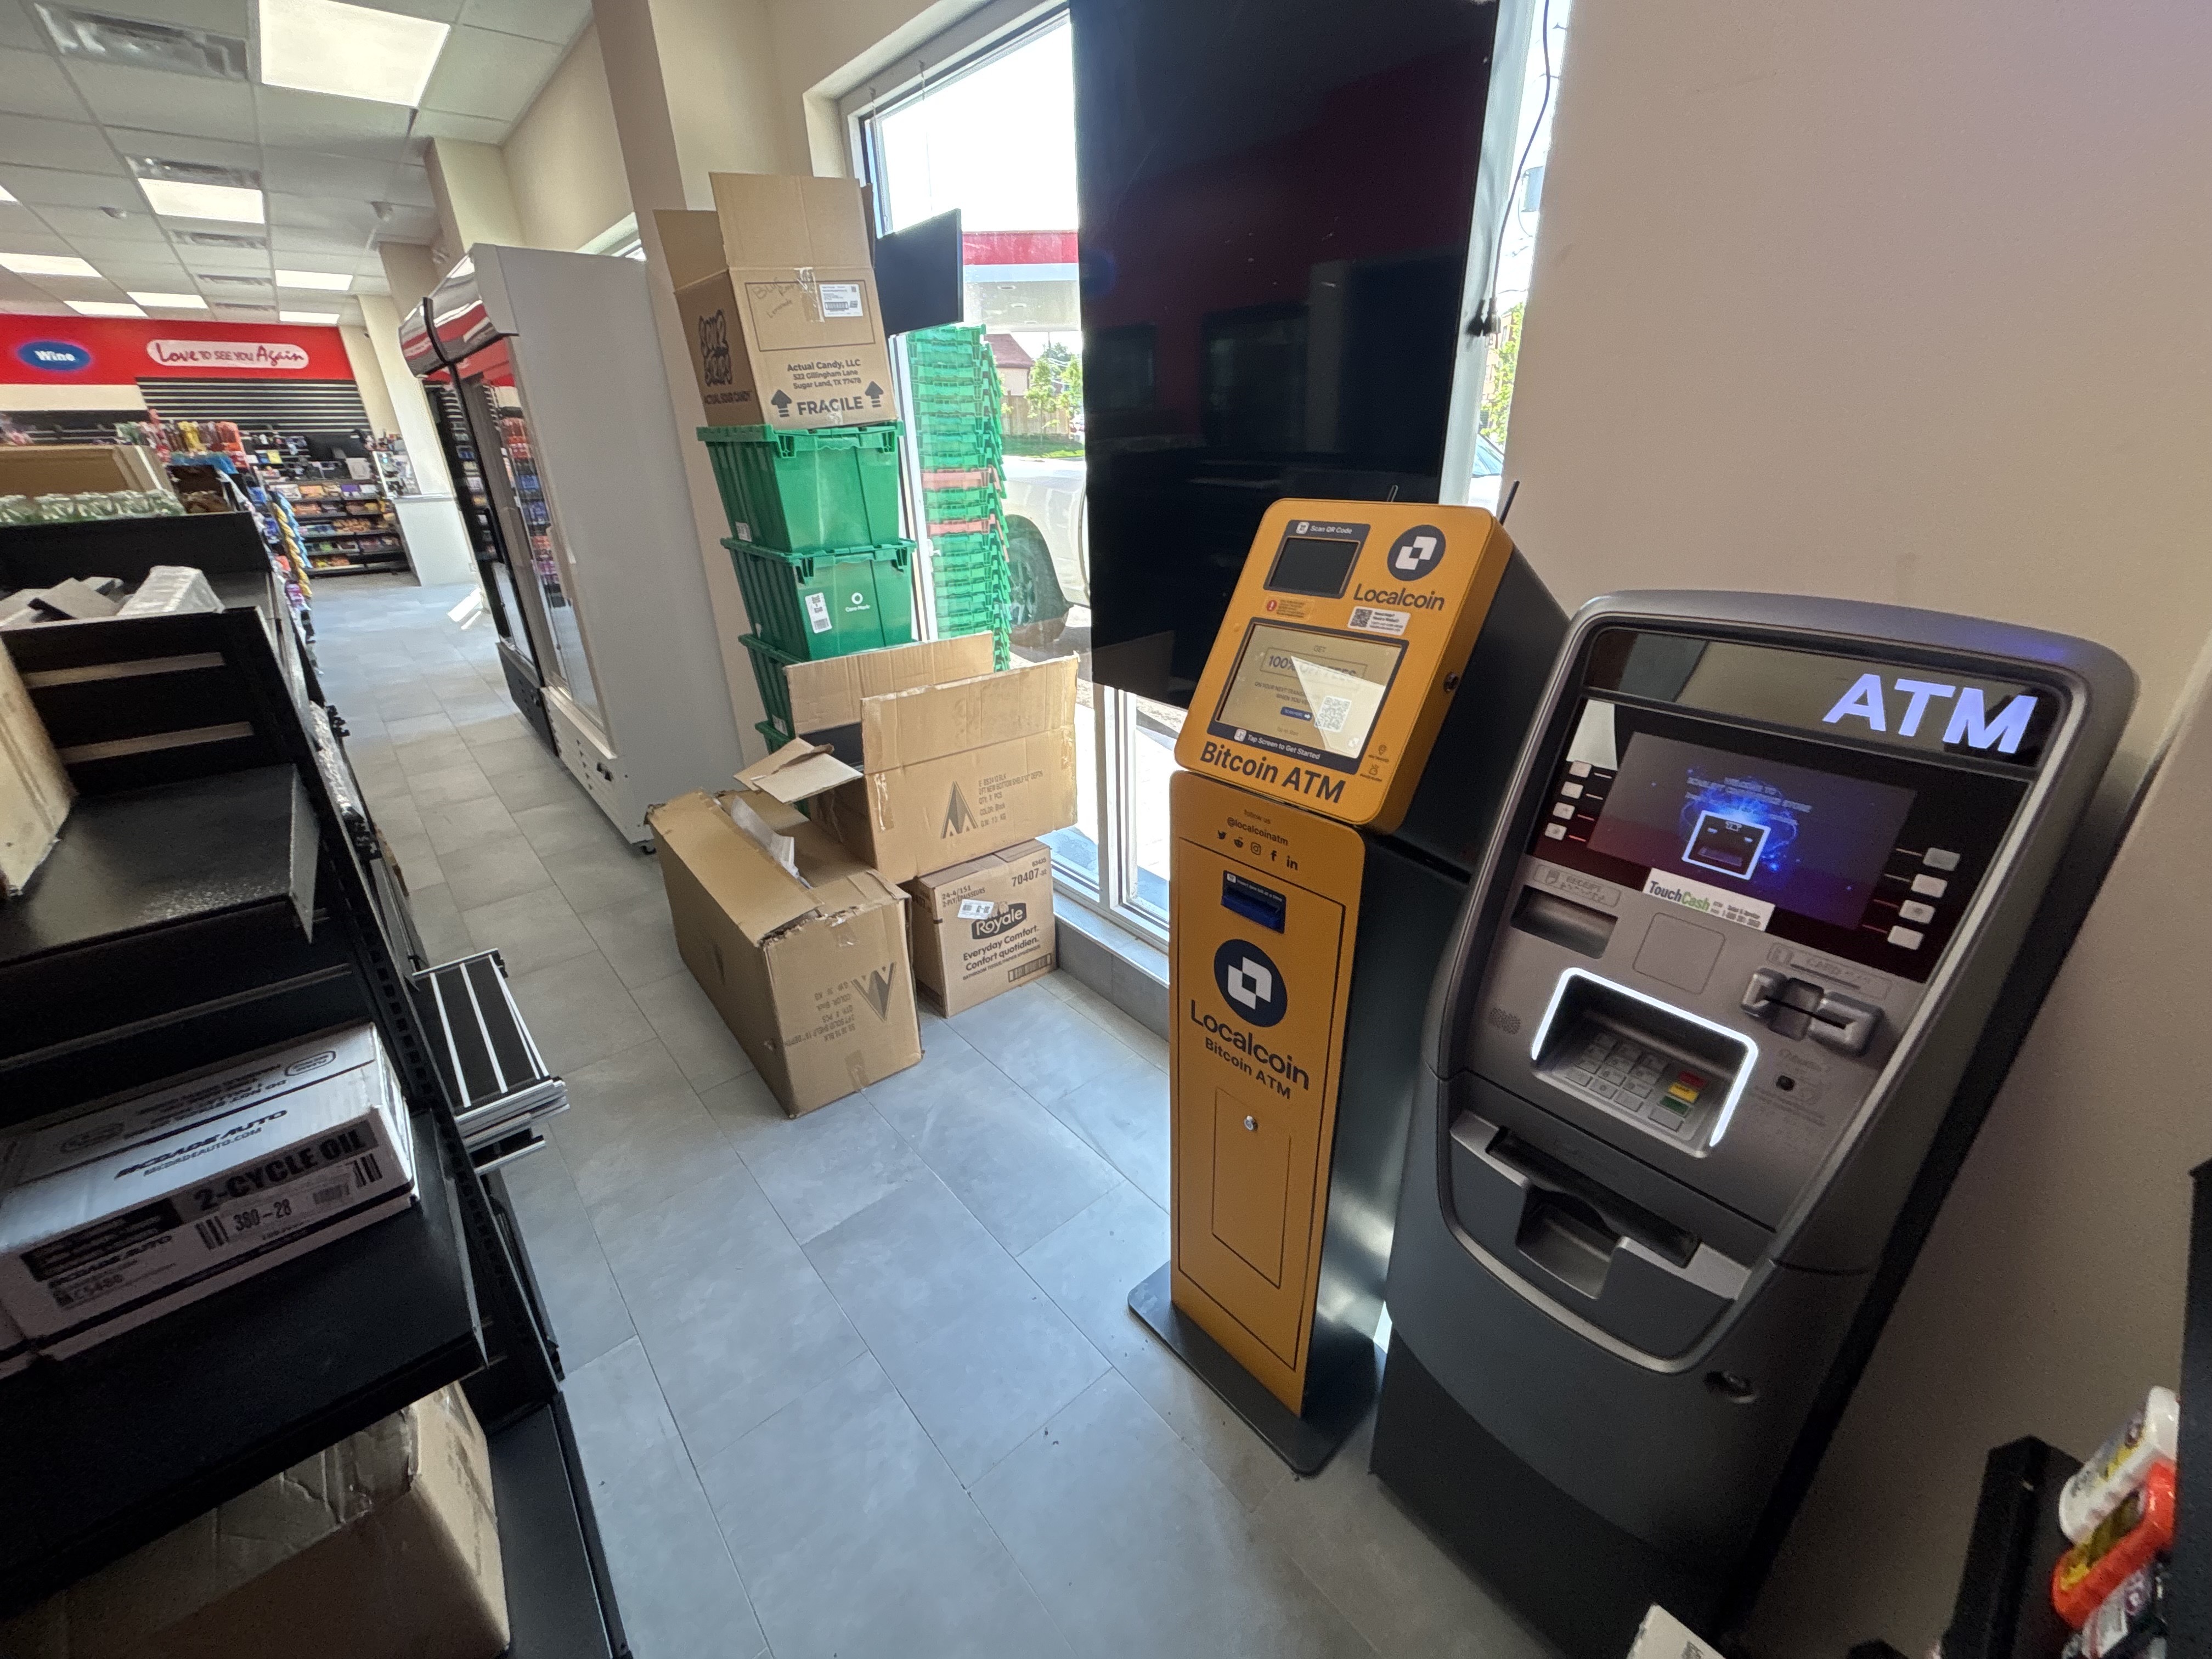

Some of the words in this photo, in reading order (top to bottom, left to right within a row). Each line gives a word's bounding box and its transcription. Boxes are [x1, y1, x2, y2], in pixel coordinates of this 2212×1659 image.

[155, 342, 199, 362] Love
[199, 351, 211, 360] TO
[213, 351, 232, 360] SEE
[256, 345, 304, 366] Again
[787, 362, 814, 371] Actual
[816, 360, 844, 369] Candy,
[845, 359, 861, 367] LLC
[1353, 583, 1445, 611] Localcoin
[1822, 673, 2039, 754] ATM
[1248, 734, 1257, 744] Tap
[1259, 738, 1278, 748] Screen
[1285, 744, 1297, 754] Get
[1297, 747, 1321, 760] Started
[1200, 741, 1279, 783] Bitcoin
[1282, 766, 1346, 804] ATM
[1227, 816, 1289, 847] @localcoinatm
[975, 908, 1024, 936] Royale
[963, 940, 1003, 961] Everyday
[966, 952, 997, 971] Confort
[998, 936, 1037, 958] quotidien
[1190, 999, 1310, 1091] Localcoin
[1205, 1036, 1252, 1076] Bitcoin
[1255, 1070, 1291, 1100] ATM
[194, 1148, 318, 1211] 2-CYCLE
[318, 1127, 365, 1160] OIL
